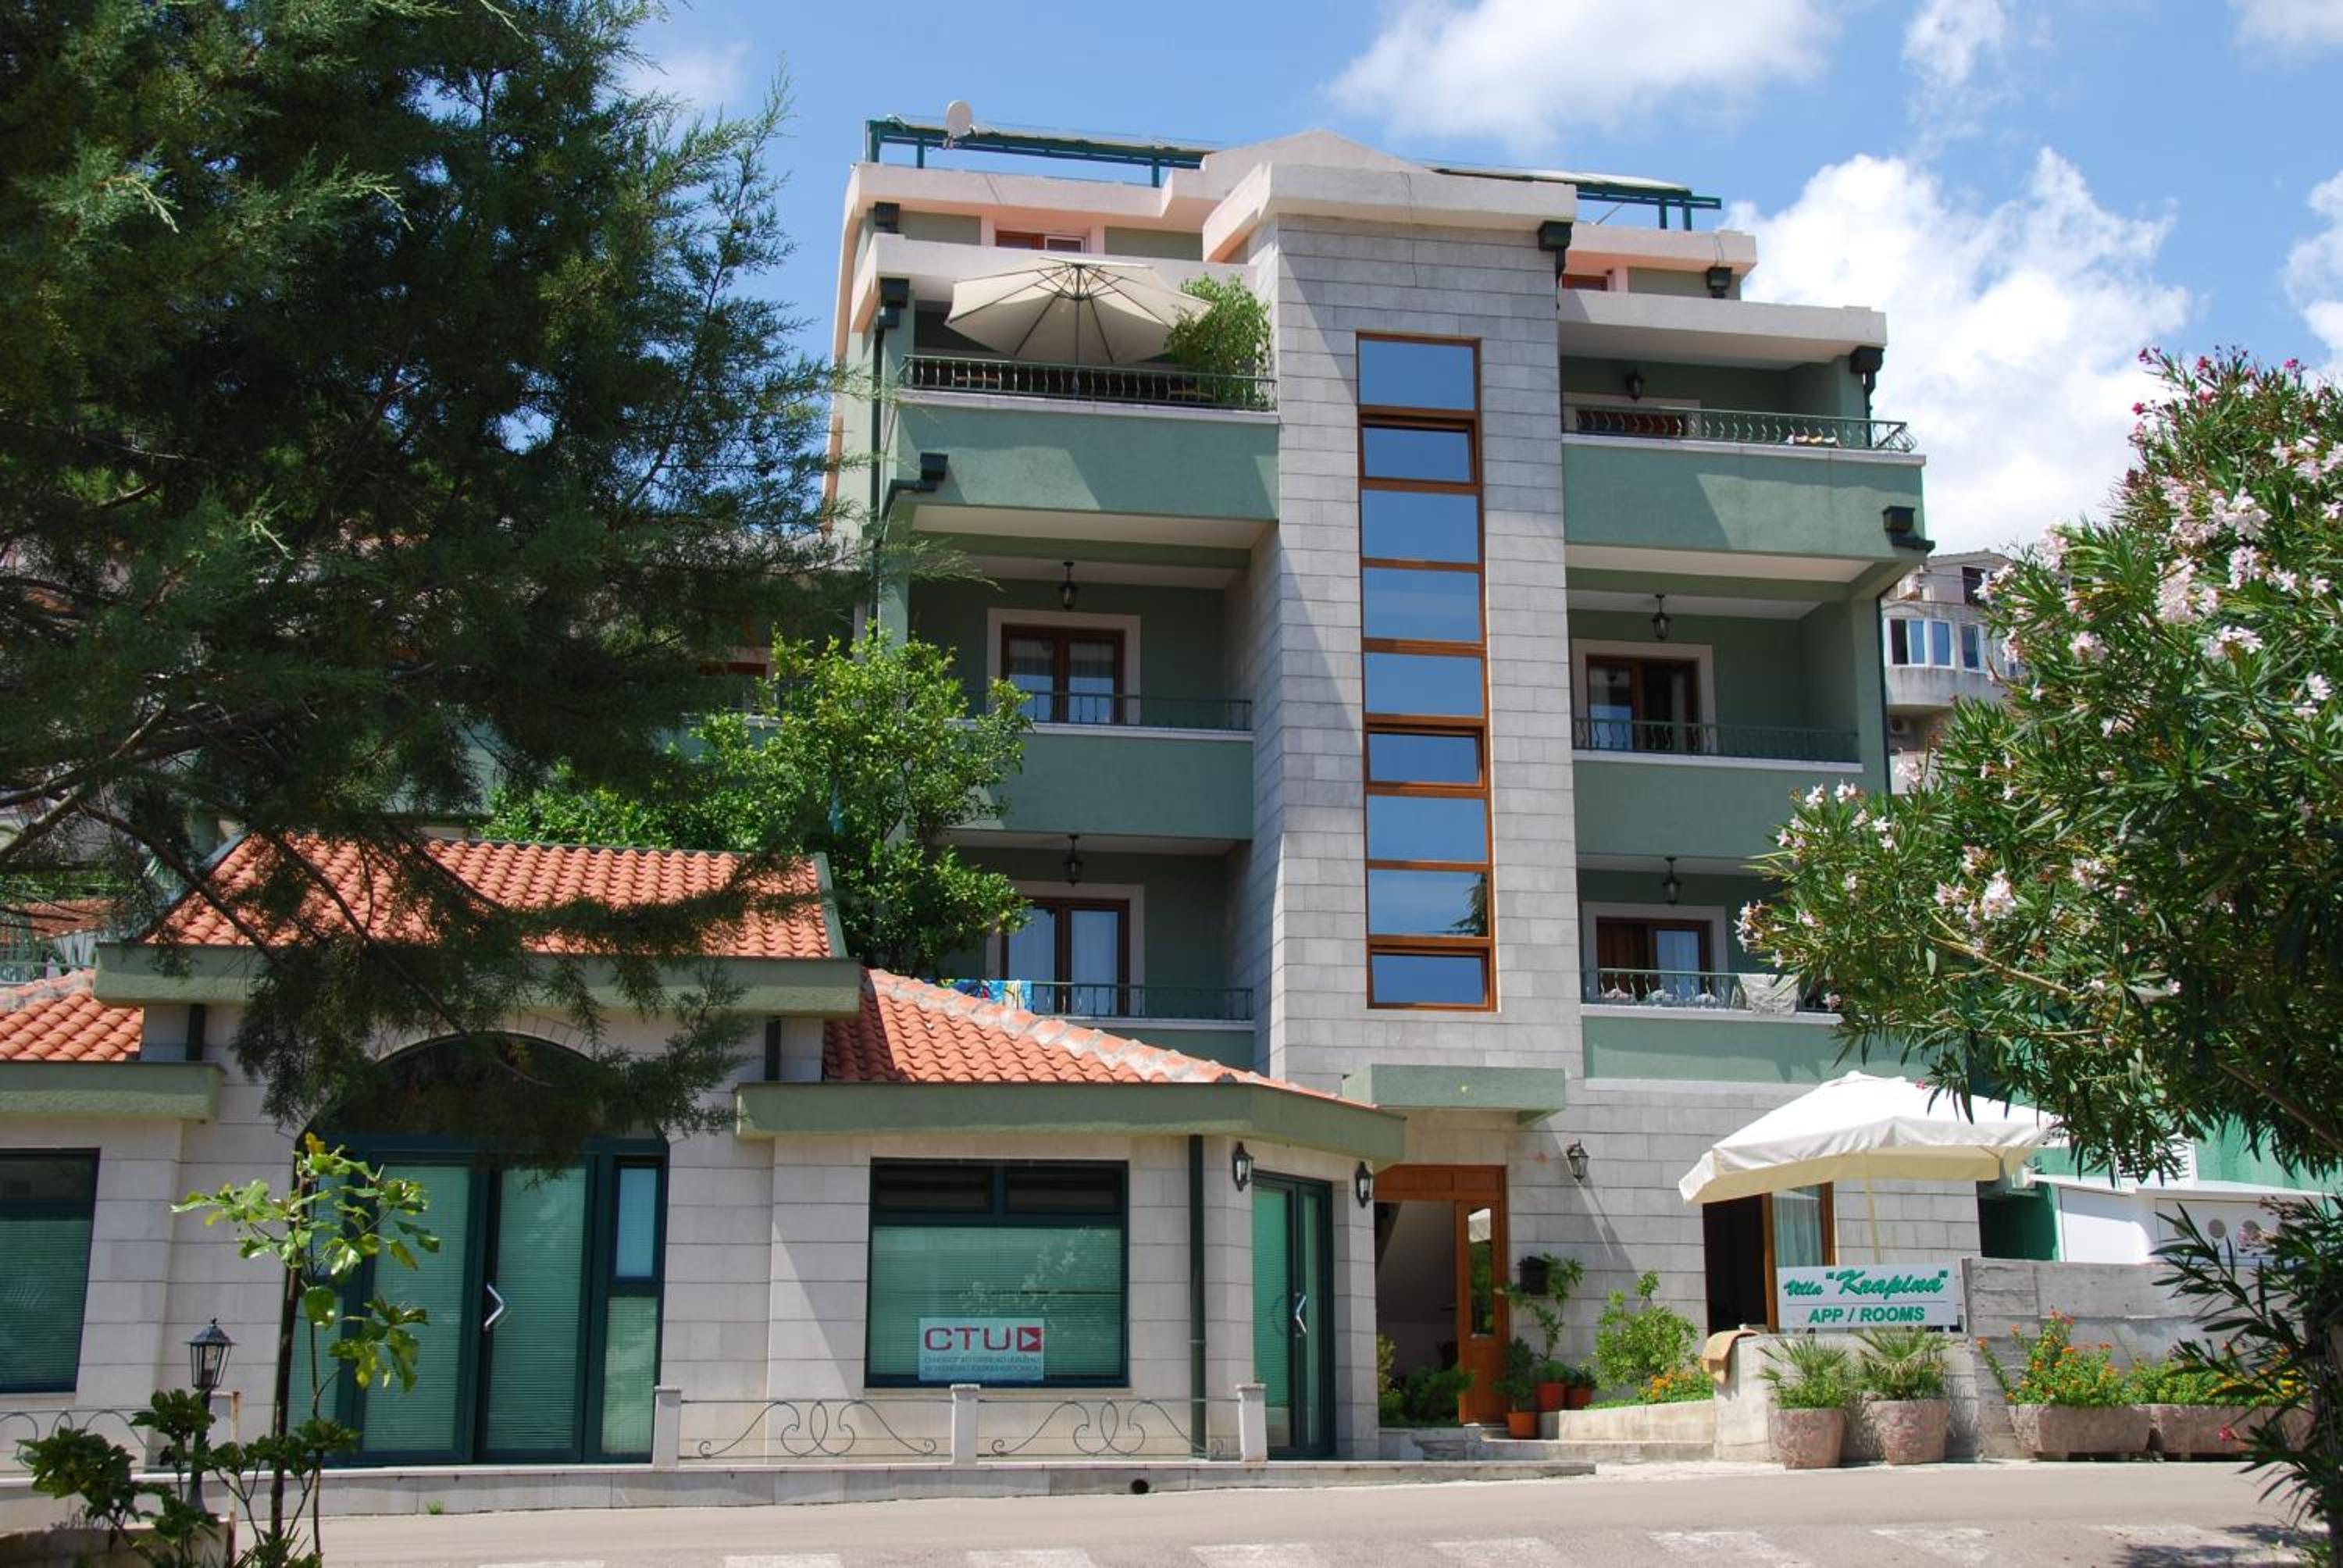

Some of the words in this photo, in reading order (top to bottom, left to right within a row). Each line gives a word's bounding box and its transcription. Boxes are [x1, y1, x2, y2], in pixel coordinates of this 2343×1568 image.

[1808, 1308, 1845, 1323] APP
[1860, 1306, 1925, 1322] ROOMS
[924, 1327, 1011, 1351] CTU
